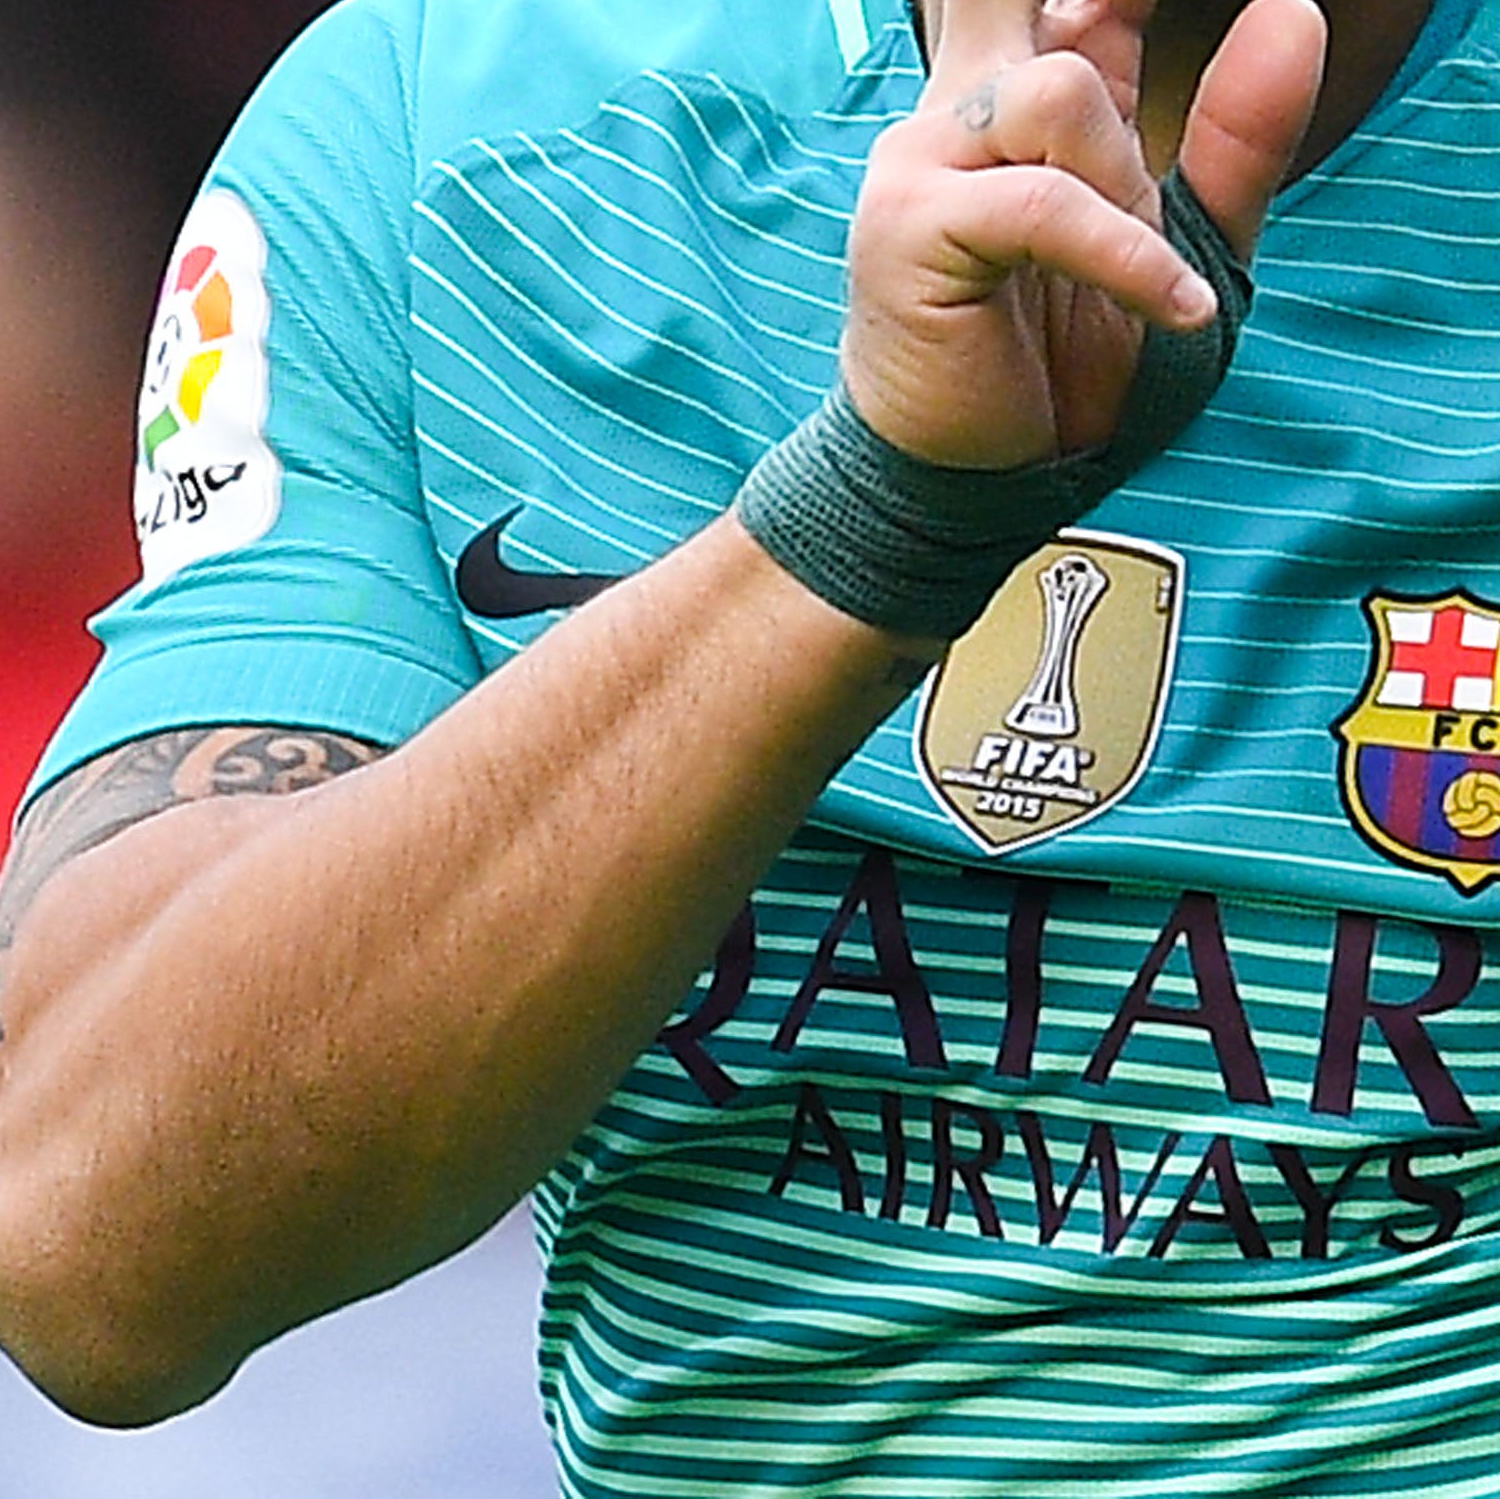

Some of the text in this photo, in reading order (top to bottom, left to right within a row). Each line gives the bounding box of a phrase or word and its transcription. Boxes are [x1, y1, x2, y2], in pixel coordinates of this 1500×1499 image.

[974, 735, 1077, 783] FIFA
[975, 792, 1042, 819] 2015
[769, 1082, 1466, 1261] AIRWAYS
